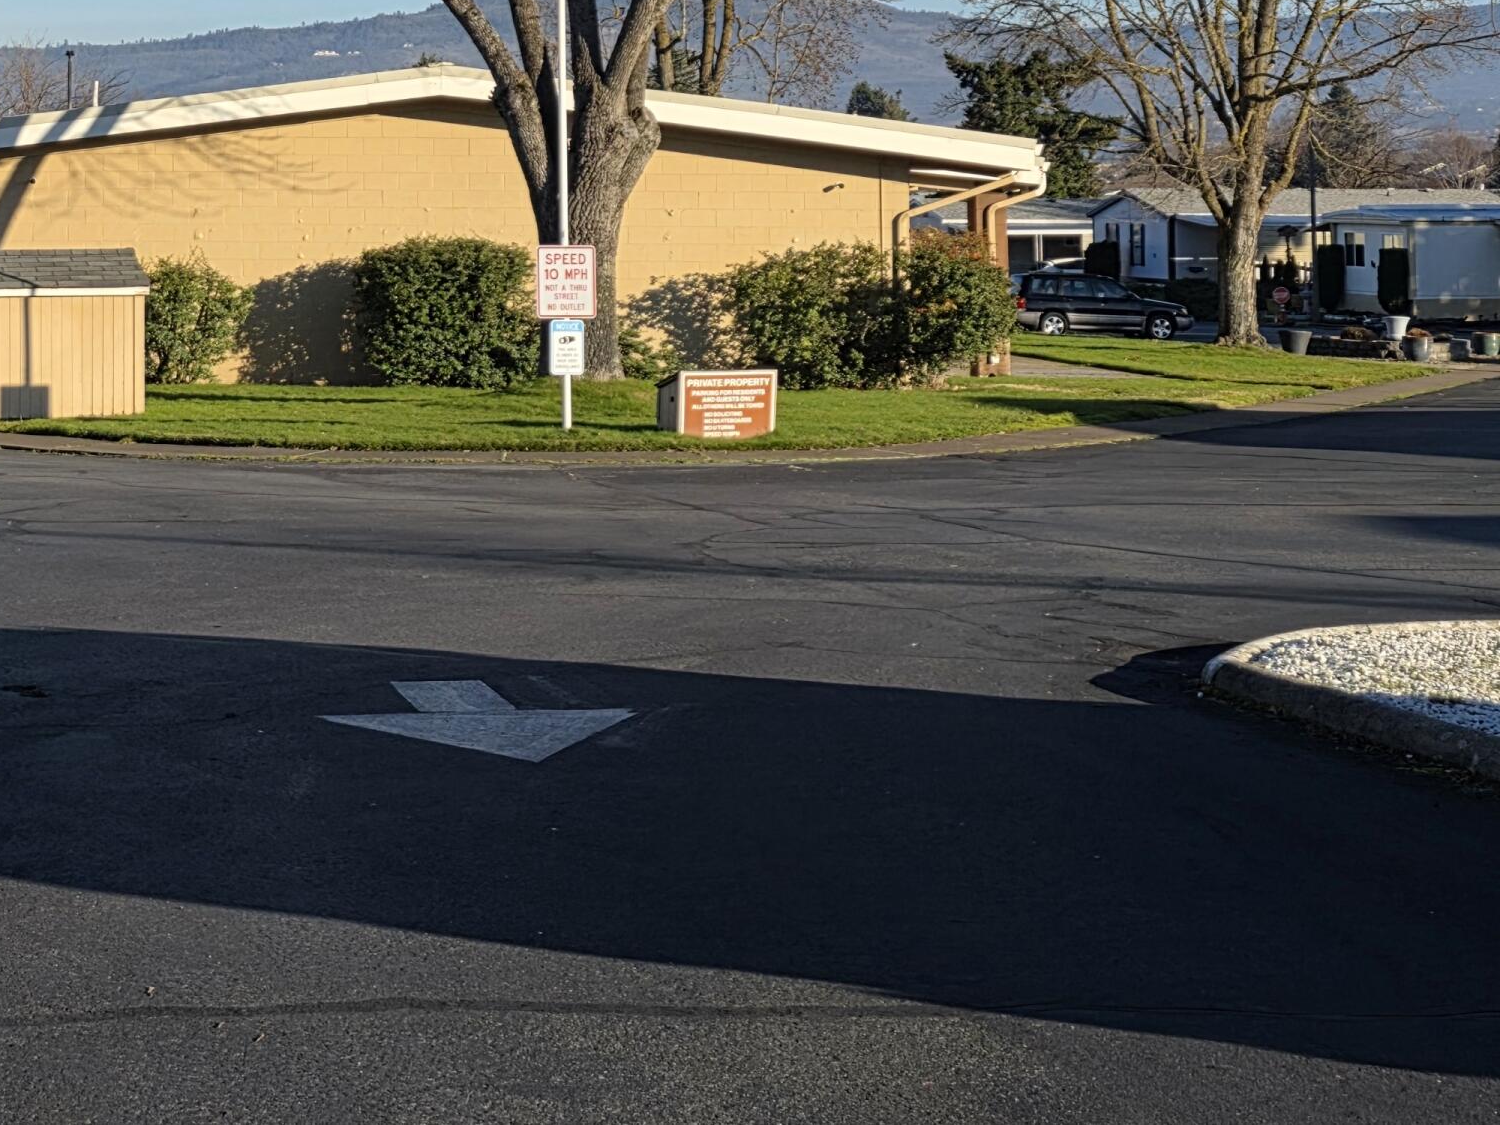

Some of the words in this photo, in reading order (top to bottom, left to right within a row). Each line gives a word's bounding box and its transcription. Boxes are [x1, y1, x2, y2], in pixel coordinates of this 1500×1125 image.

[545, 253, 586, 265] SPEED
[544, 268, 559, 280] 10
[565, 268, 588, 280] MPH
[686, 378, 723, 387] PRIVATE
[724, 377, 770, 386] PROPERTY
